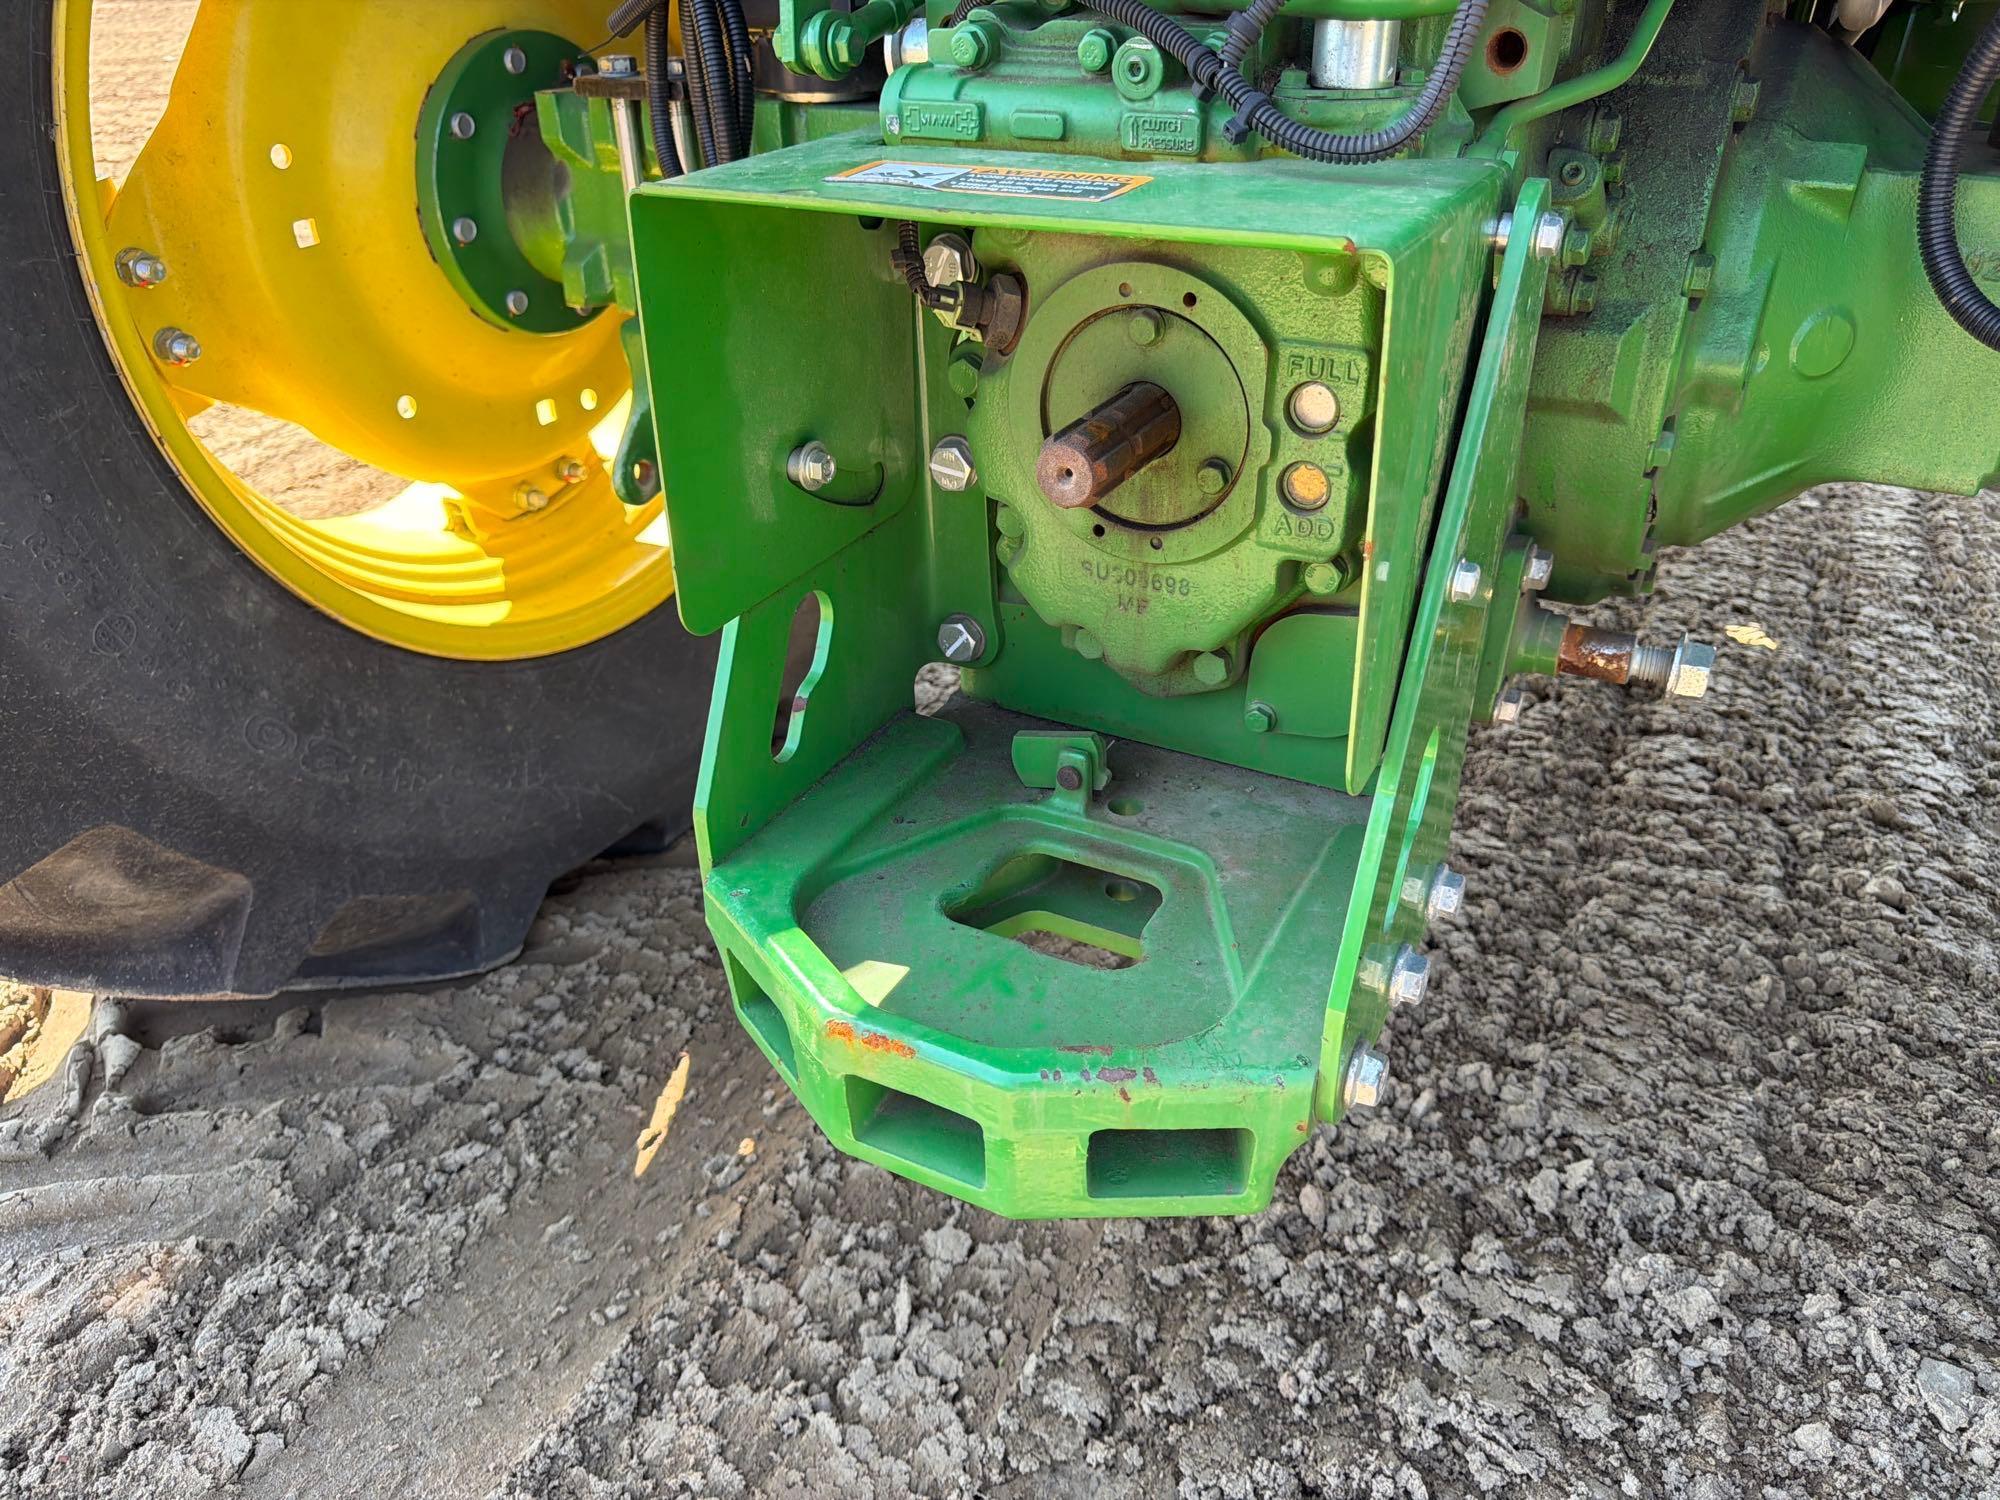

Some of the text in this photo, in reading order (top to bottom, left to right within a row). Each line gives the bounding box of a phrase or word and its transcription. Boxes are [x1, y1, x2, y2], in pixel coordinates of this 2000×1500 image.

[1141, 119, 1184, 133] CLUTCH
[1141, 136, 1195, 151] PRESSURE
[1006, 170, 1135, 183] WARNING
[1287, 355, 1360, 385] FULL
[1273, 513, 1335, 542] ADD
